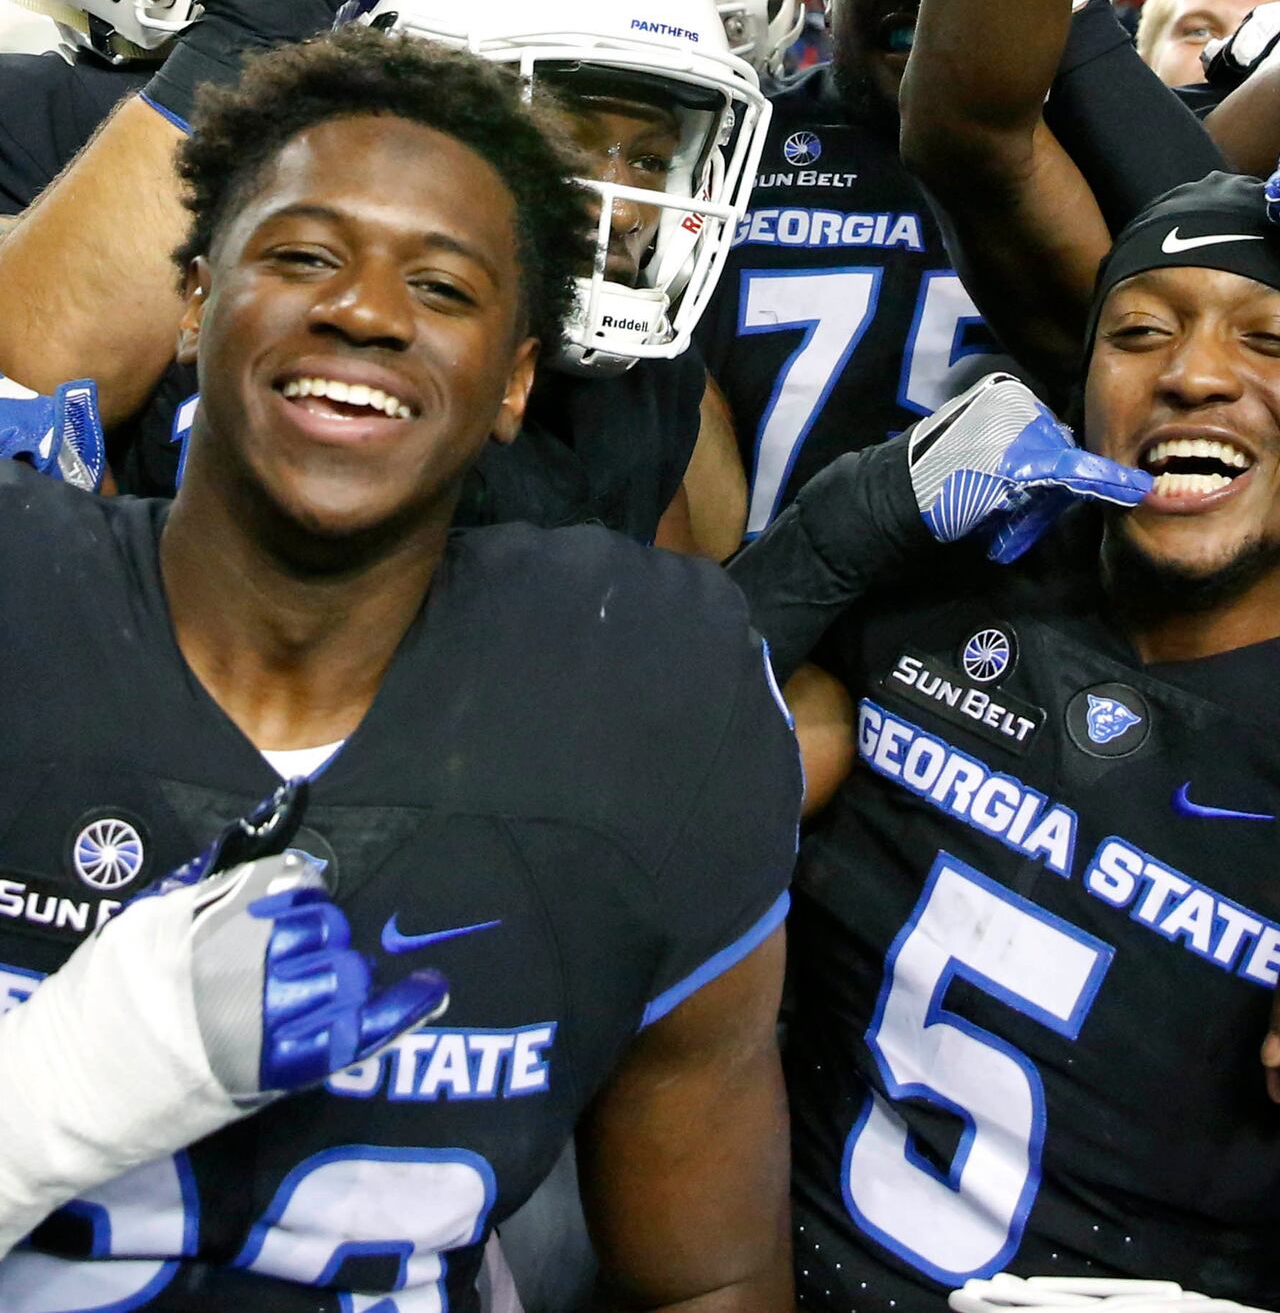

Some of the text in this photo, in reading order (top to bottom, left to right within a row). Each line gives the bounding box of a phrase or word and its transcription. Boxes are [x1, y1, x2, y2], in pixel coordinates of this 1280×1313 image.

[630, 18, 700, 44] PANTHERS
[796, 170, 858, 188] BELT
[731, 208, 923, 250] GEORGIA
[601, 315, 650, 333] Riddell
[892, 653, 1038, 743] SUN BELT
[857, 697, 1080, 879] GEORGIA
[326, 1022, 558, 1101] STATE
[840, 849, 1117, 1287] 5
